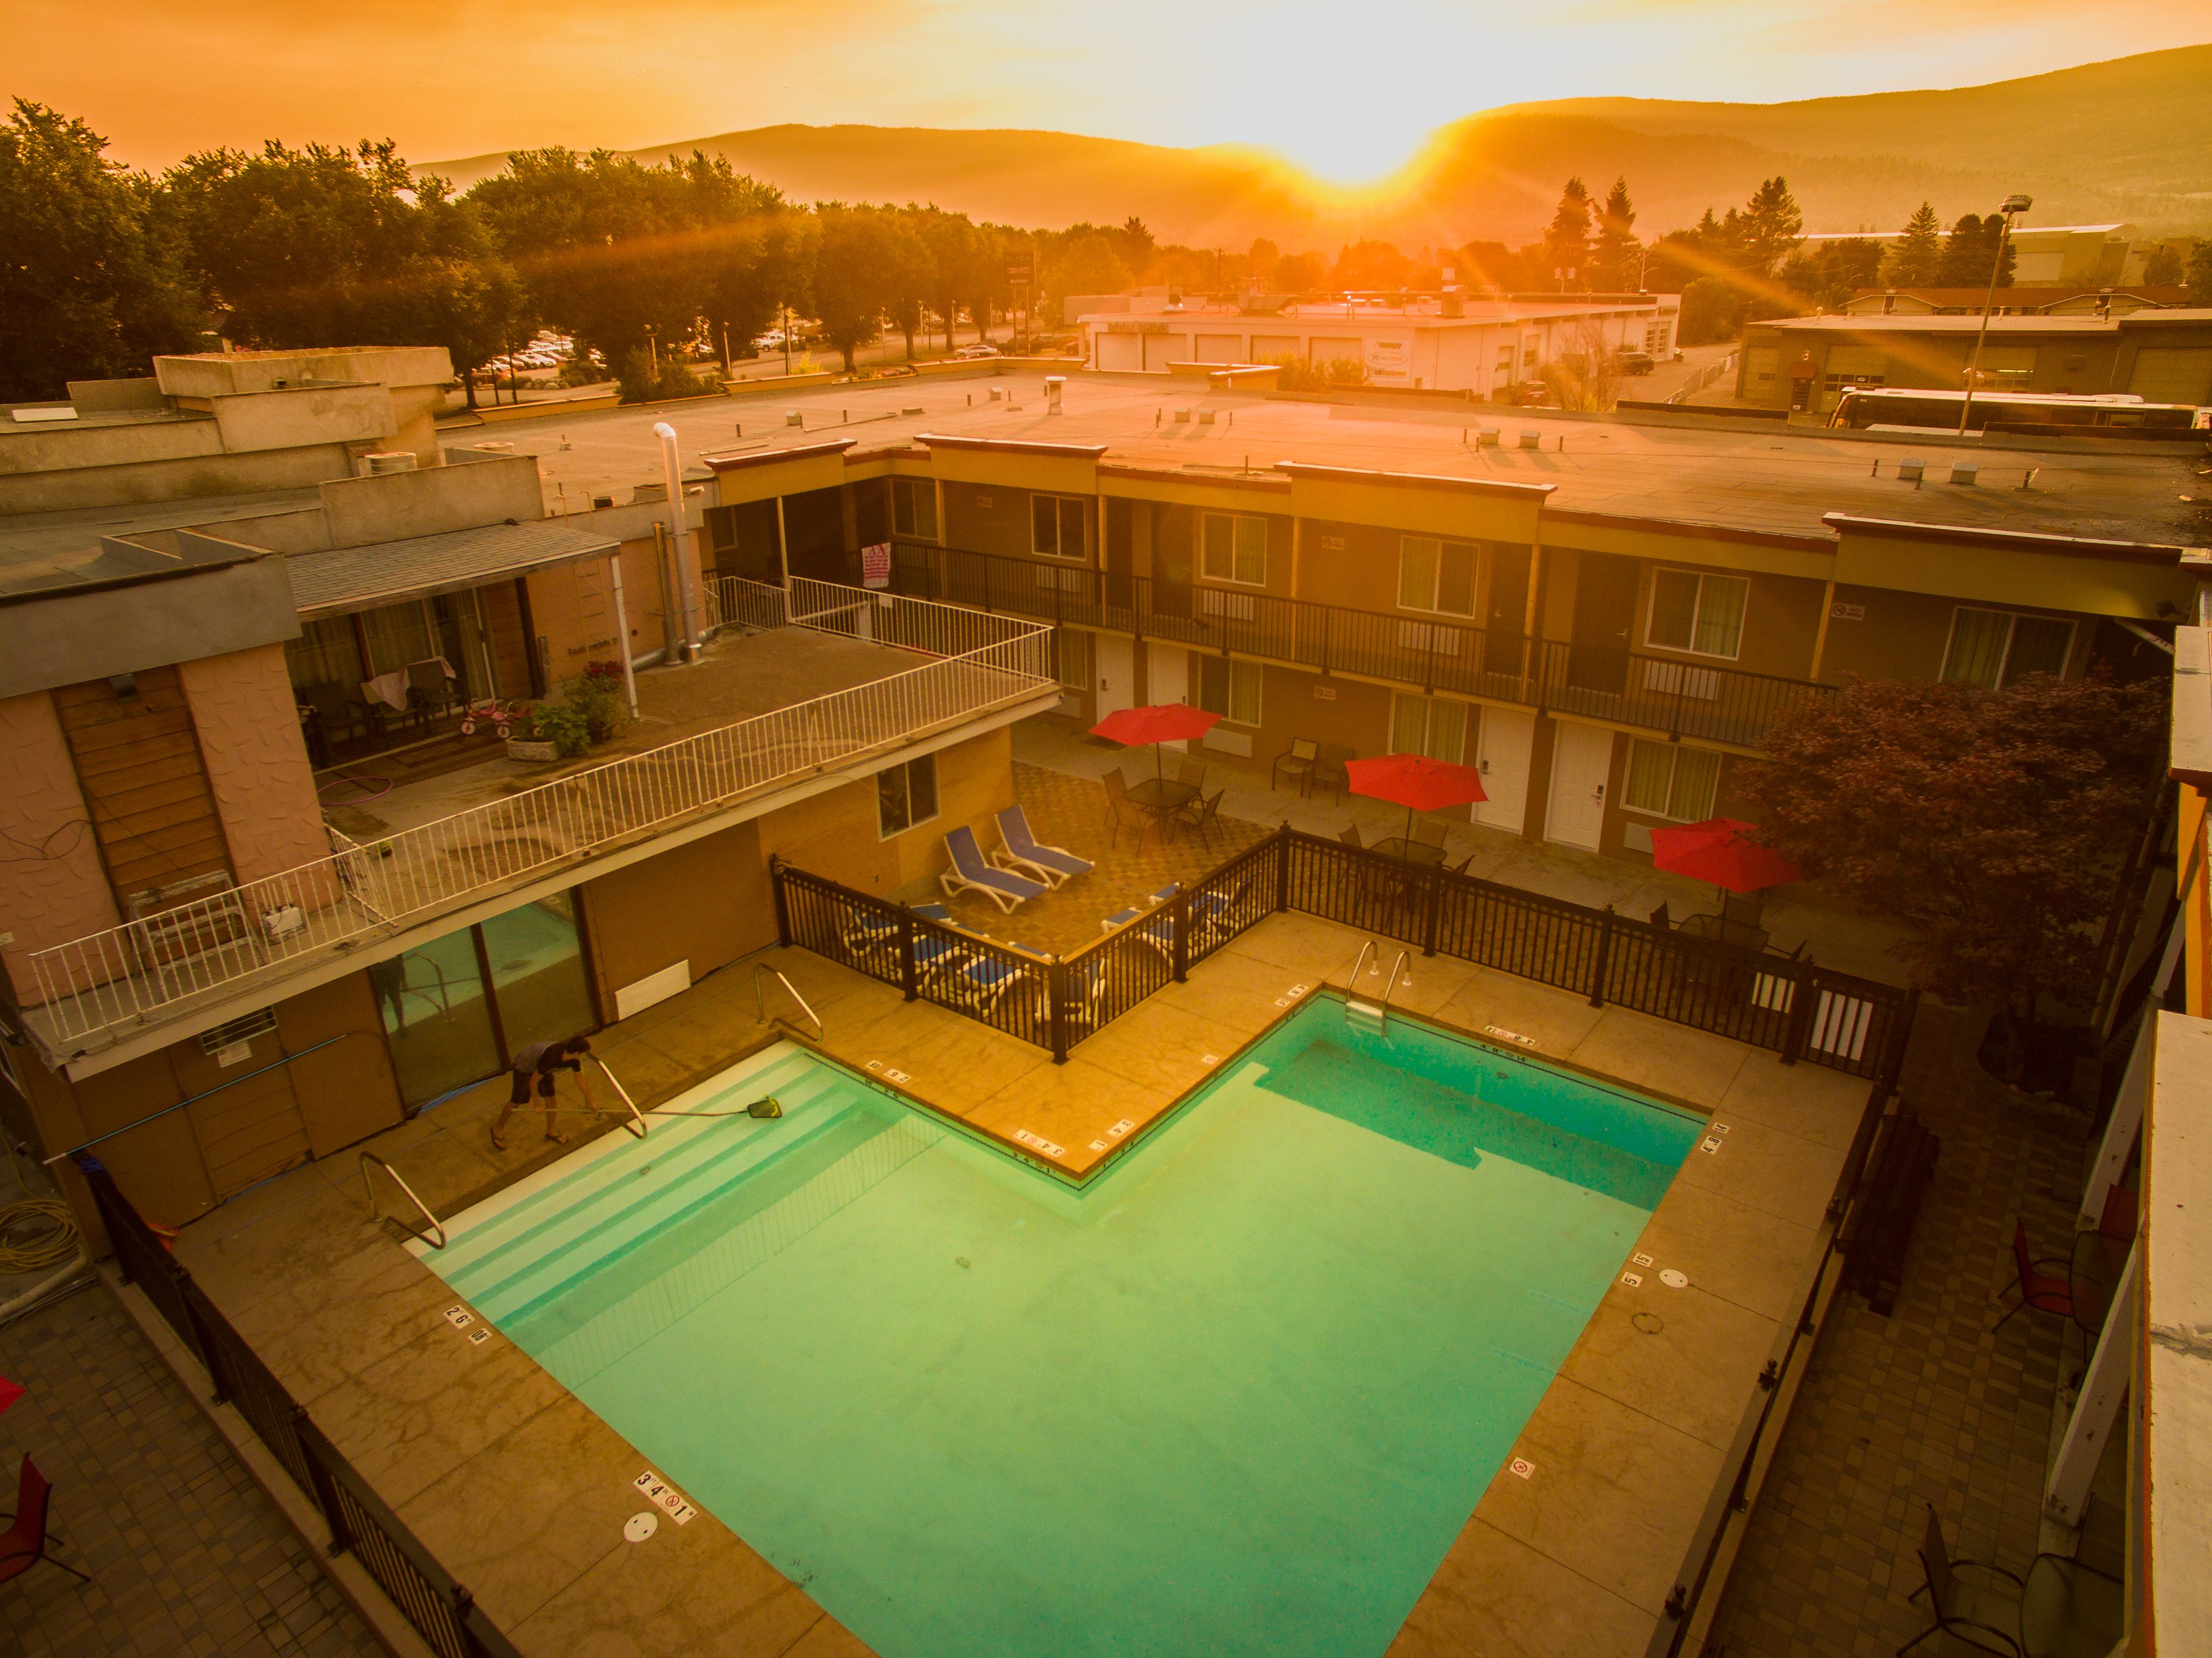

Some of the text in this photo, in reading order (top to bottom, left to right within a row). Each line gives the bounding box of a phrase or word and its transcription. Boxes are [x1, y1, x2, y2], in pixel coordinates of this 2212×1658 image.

[1635, 1255, 1650, 1265] 15
[1624, 1276, 1638, 1285] 5
[446, 1306, 460, 1316] 2
[455, 1315, 468, 1324] 6
[471, 1329, 487, 1341] 08
[637, 1474, 652, 1485] 3
[651, 1485, 664, 1497] 4
[674, 1505, 687, 1517] 1
